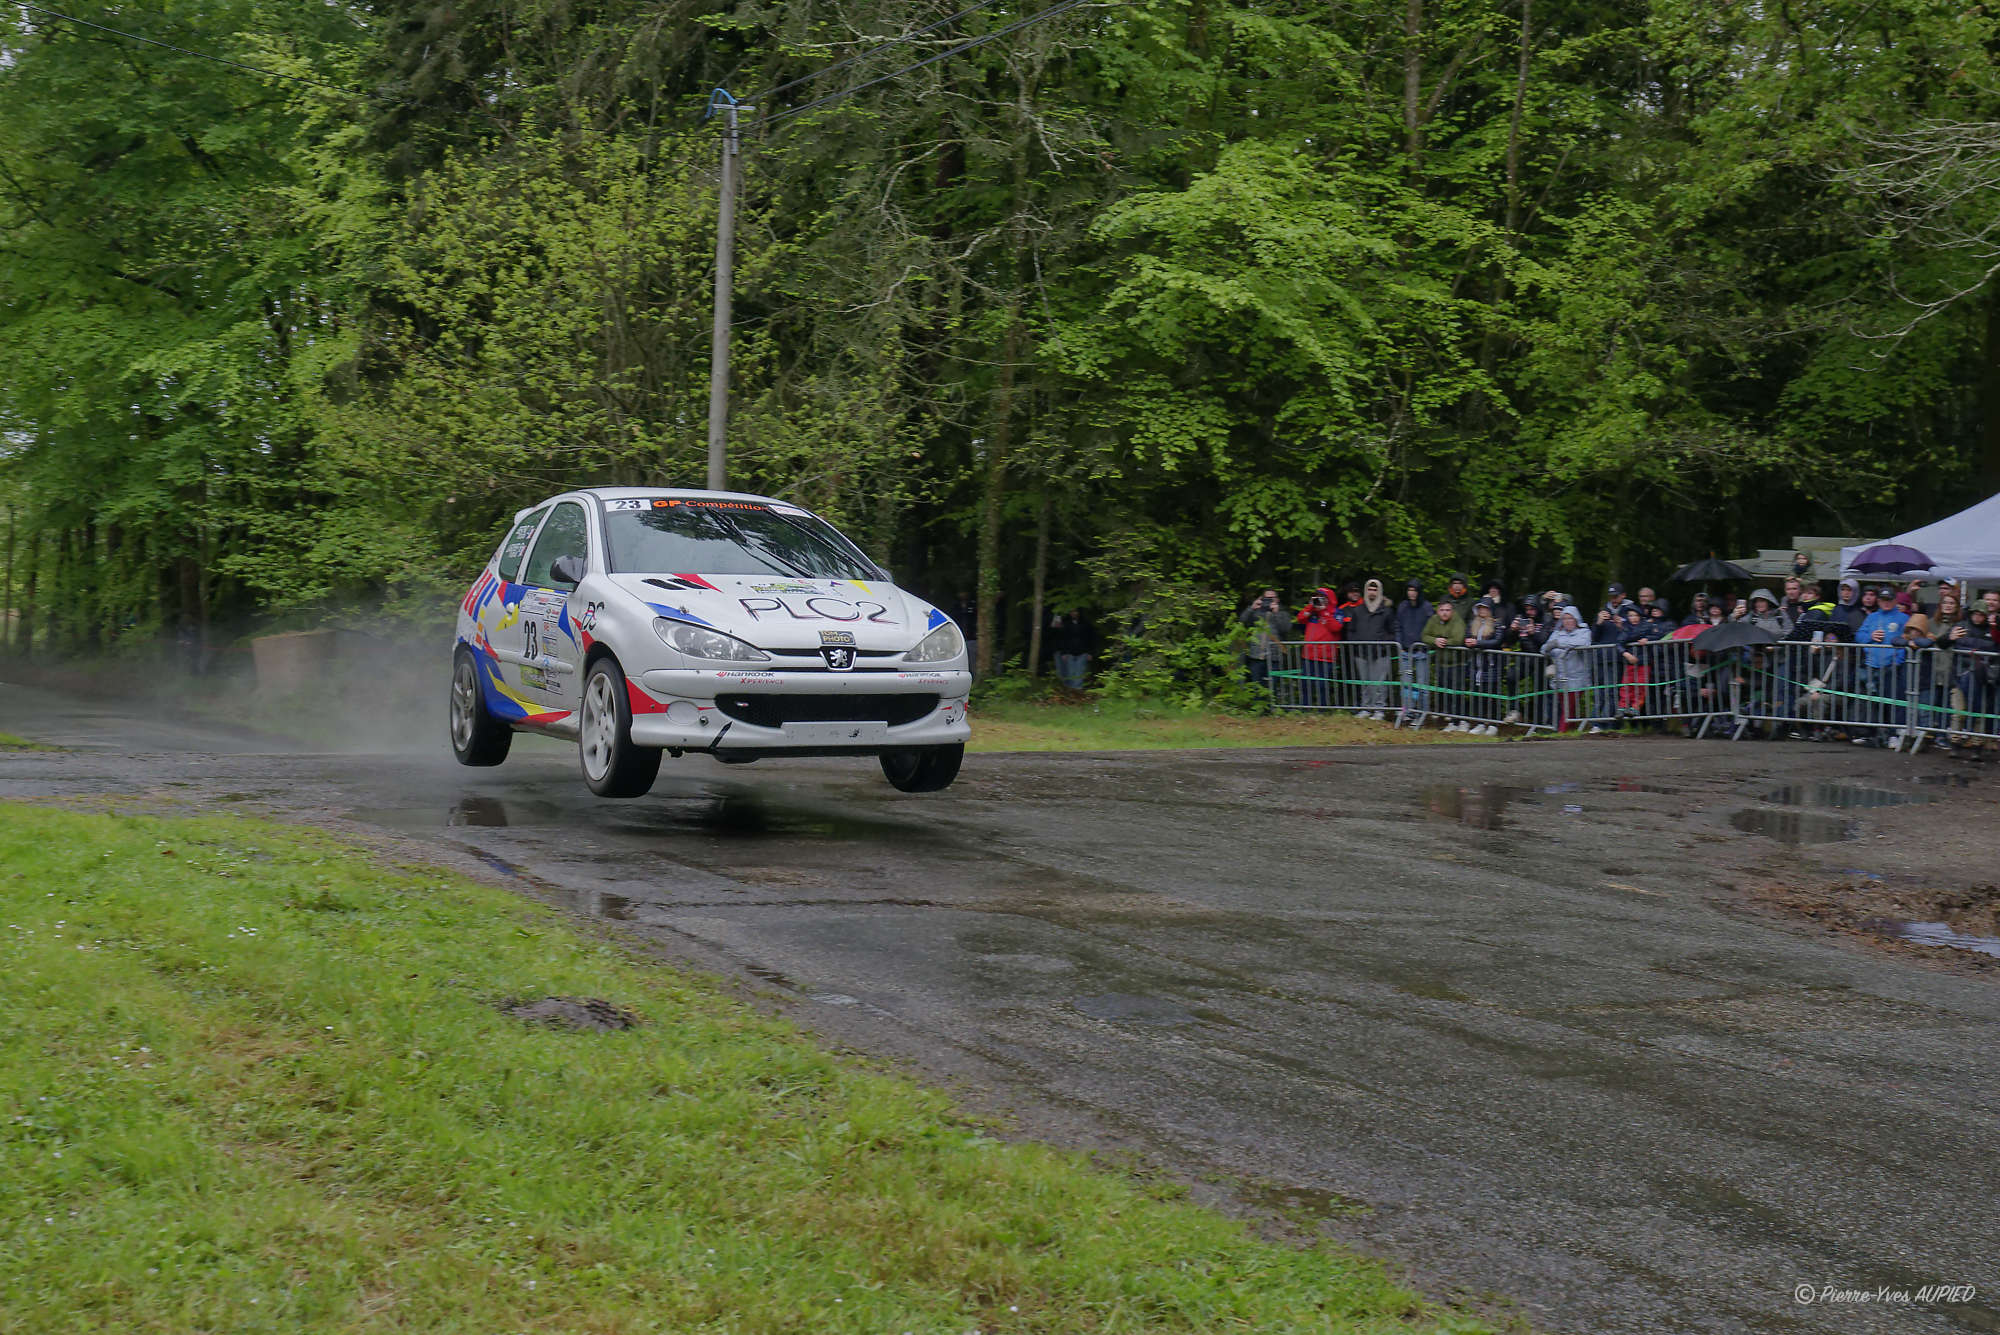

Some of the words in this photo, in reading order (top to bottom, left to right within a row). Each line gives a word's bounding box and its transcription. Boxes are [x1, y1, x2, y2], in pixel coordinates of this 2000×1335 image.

[615, 500, 641, 510] 23
[653, 499, 682, 509] GP
[523, 620, 539, 661] 23
